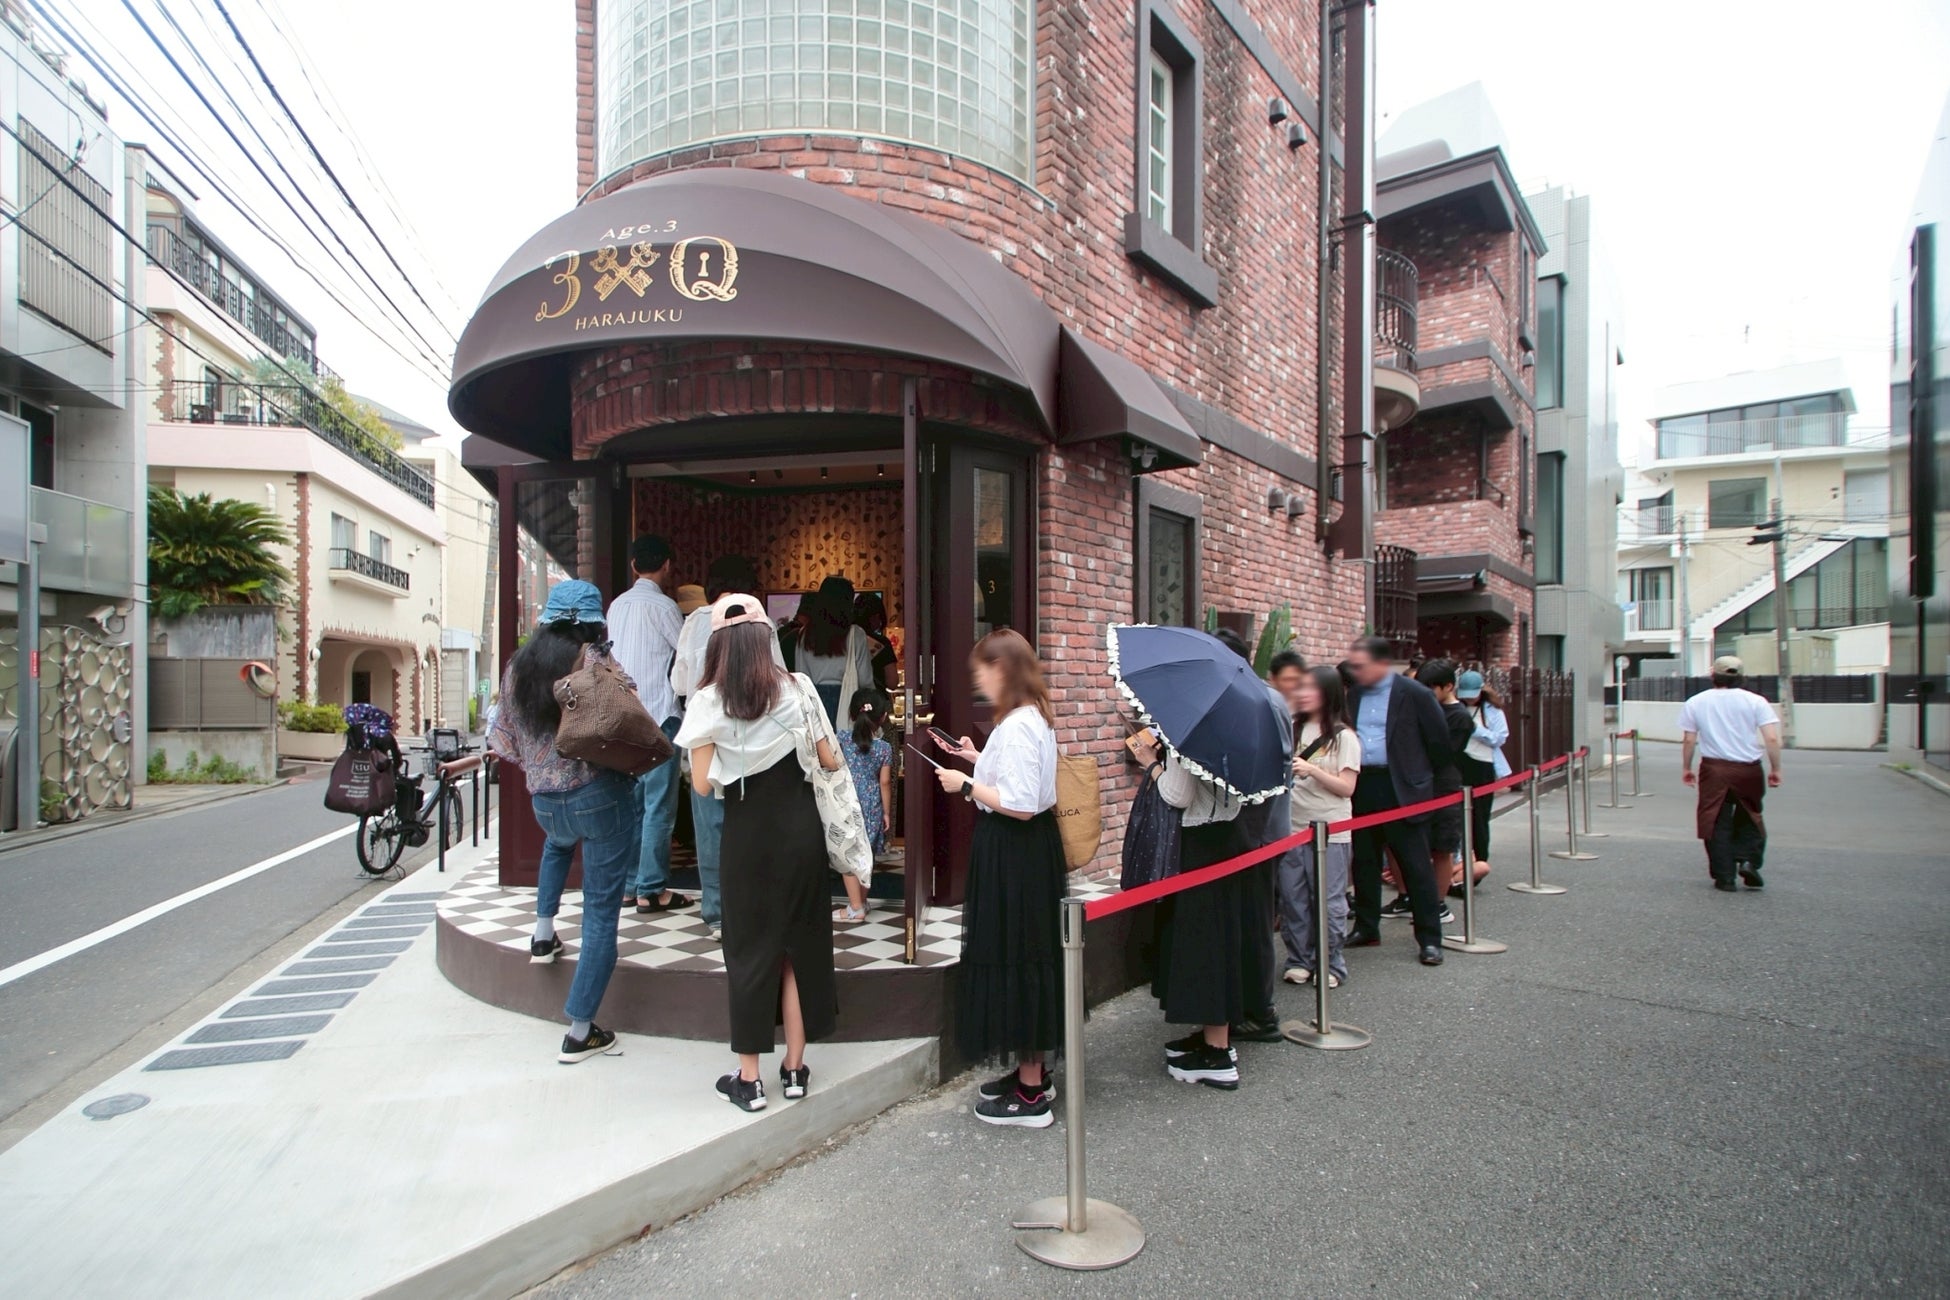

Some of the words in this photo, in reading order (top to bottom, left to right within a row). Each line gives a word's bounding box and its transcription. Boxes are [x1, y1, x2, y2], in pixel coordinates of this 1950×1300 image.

[535, 250, 582, 322] 3
[669, 235, 738, 302] Q
[575, 309, 683, 331] HARAJUKU
[988, 580, 996, 594] 3
